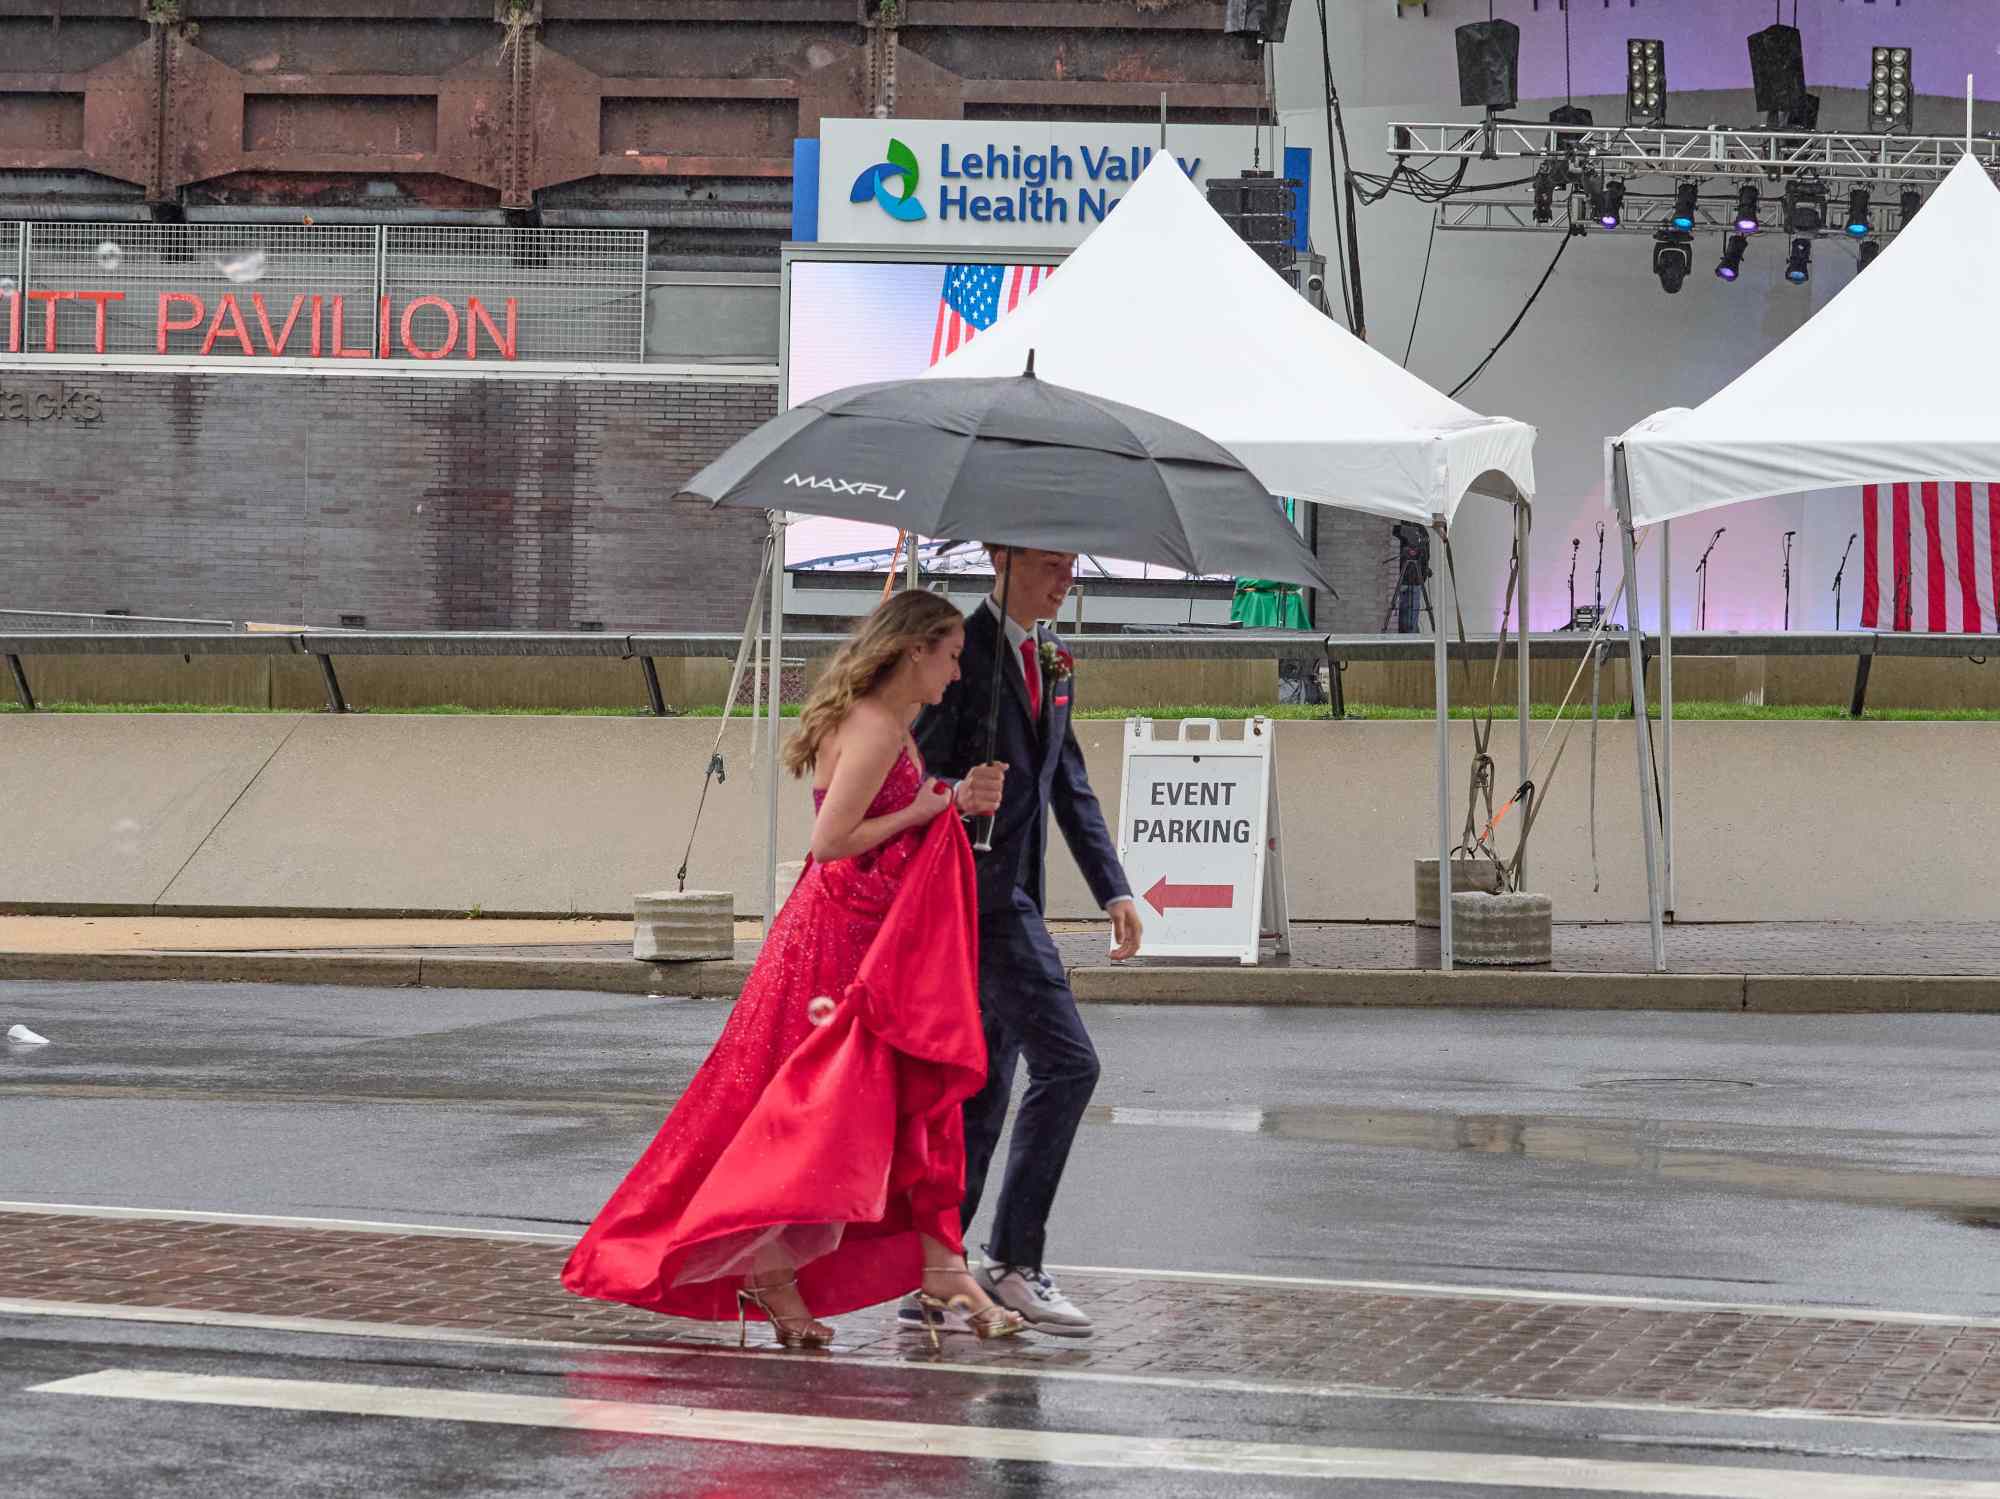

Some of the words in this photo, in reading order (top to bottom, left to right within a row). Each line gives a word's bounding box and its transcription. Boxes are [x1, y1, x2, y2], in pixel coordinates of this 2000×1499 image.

[941, 143, 1073, 188] Lehigh
[1079, 145, 1201, 183] Vally
[939, 185, 1068, 223] Health
[0, 290, 125, 354] ITT
[156, 291, 518, 360] PAVILION
[783, 473, 906, 501] MAXFLI
[1151, 782, 1237, 806] EVENT
[1133, 819, 1251, 844] PARKING
